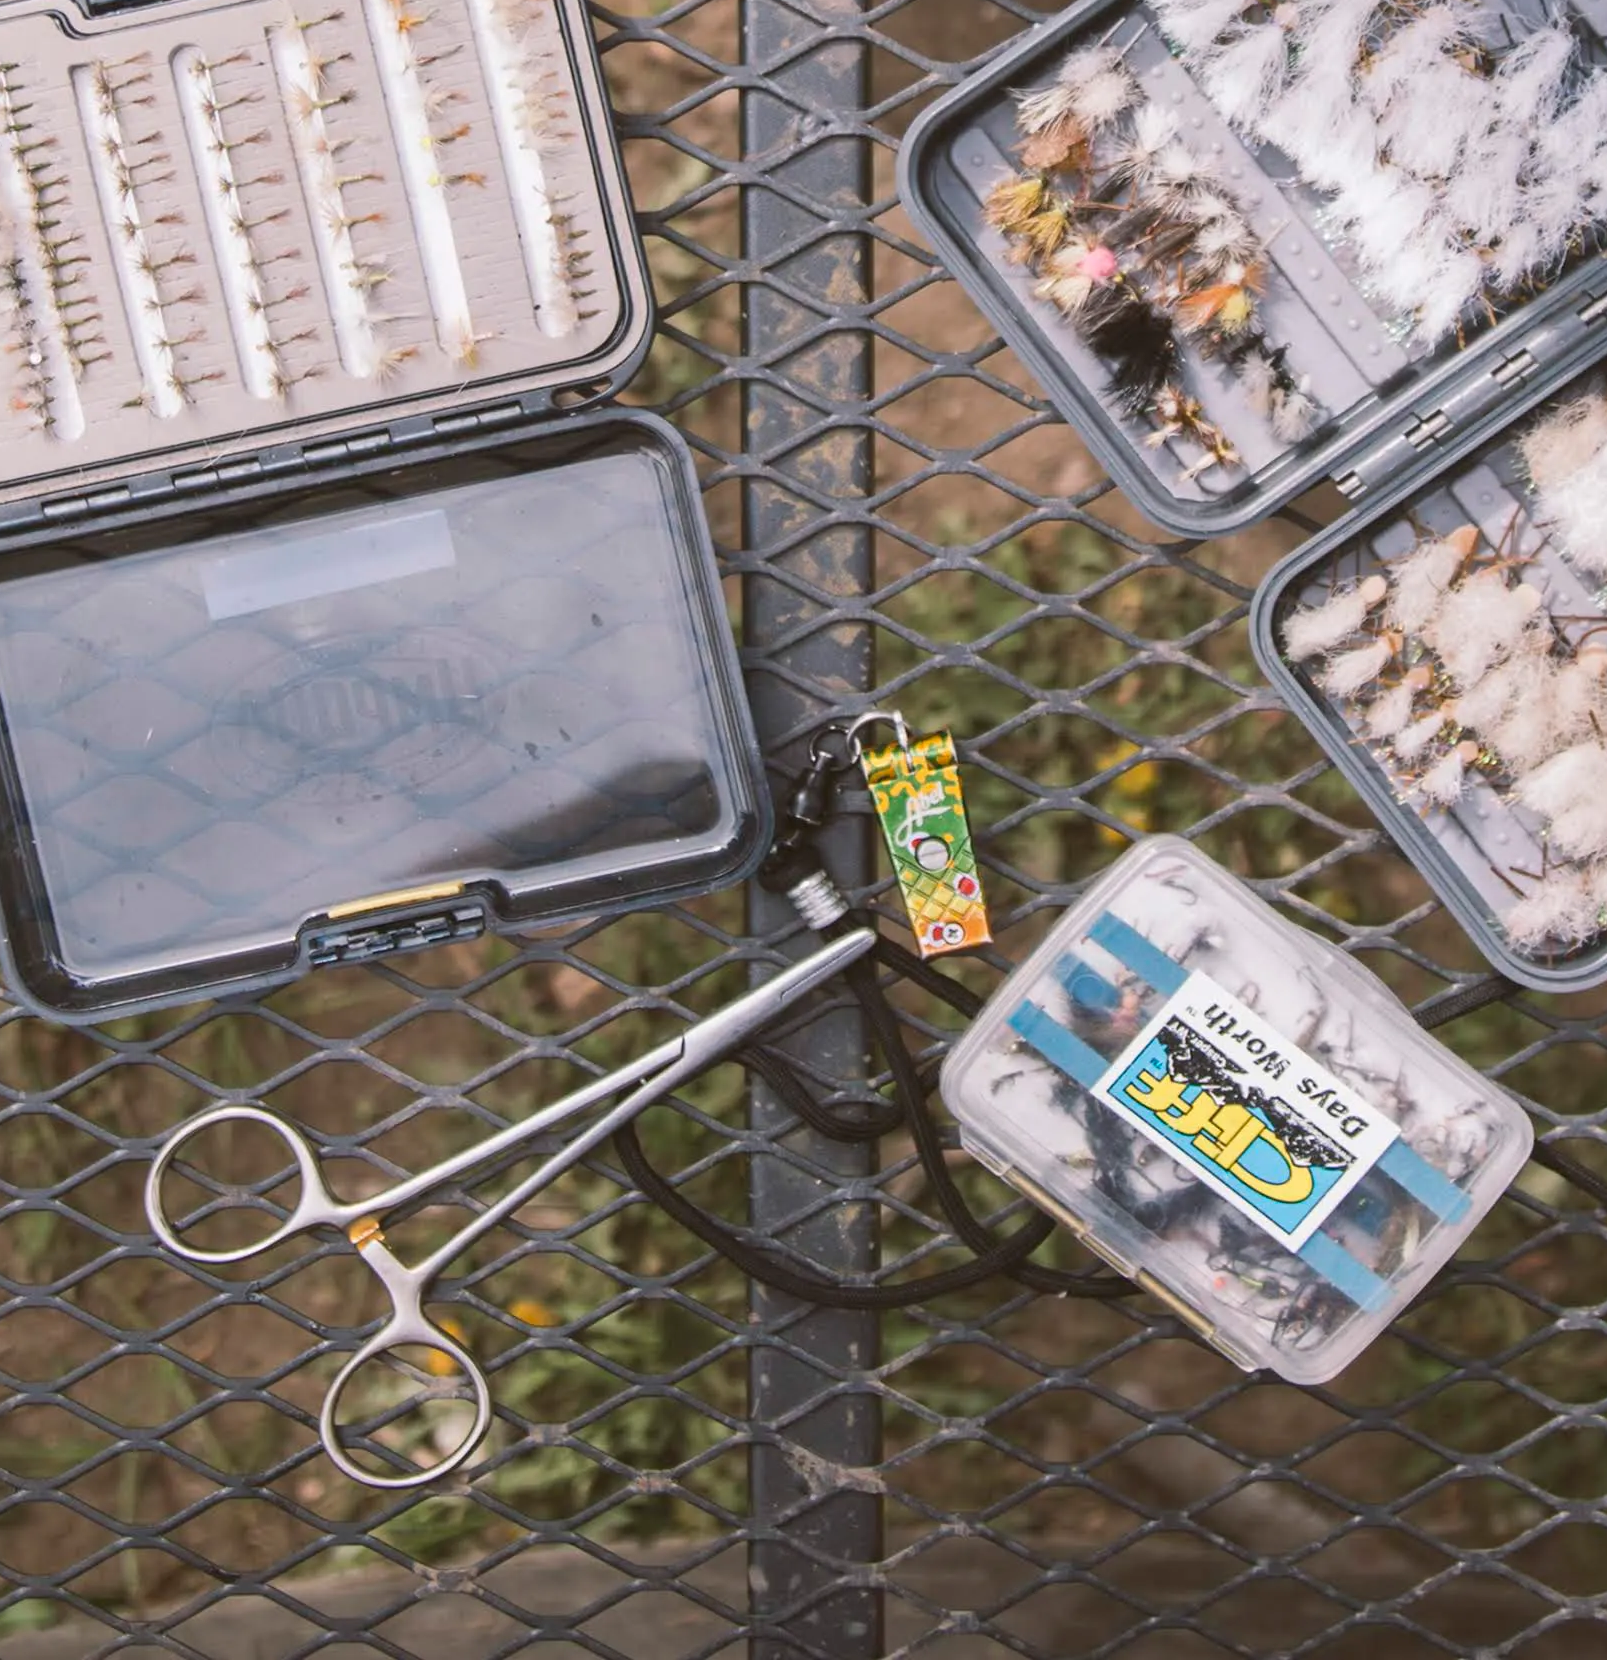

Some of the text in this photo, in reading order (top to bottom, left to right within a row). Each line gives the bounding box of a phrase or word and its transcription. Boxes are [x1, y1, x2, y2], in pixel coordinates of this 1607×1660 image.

[894, 781, 951, 847] Abel
[1204, 1004, 1290, 1079] Worth
[1297, 1079, 1368, 1137] Days
